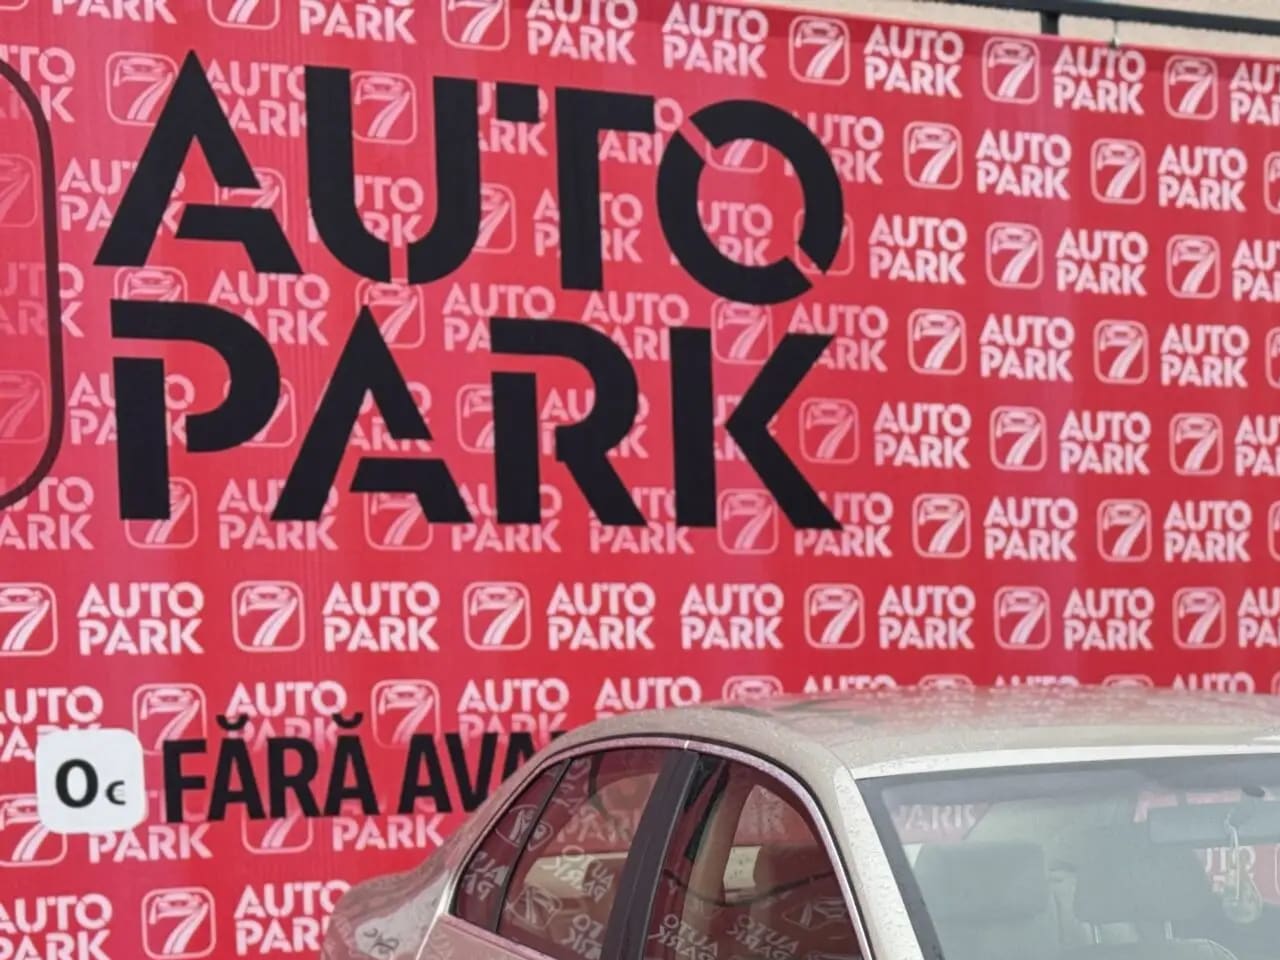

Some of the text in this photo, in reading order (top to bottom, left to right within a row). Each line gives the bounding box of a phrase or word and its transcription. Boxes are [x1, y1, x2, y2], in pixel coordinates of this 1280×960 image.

[300, 5, 416, 44] PARK
[527, 0, 637, 29] AUTO
[662, 2, 769, 43] AUTO
[528, 20, 636, 65] PARK
[664, 34, 766, 78] PARK
[864, 24, 964, 64] AUTO
[865, 56, 962, 98] PARK
[1053, 46, 1146, 81] AUTO
[1054, 75, 1144, 115] PARK
[976, 129, 1071, 167] AUTO
[1158, 144, 1247, 180] AUTO
[94, 50, 843, 304] AUTO
[977, 161, 1070, 200] PARK
[1159, 174, 1246, 212] PARK
[869, 214, 967, 251] AUTO
[1056, 228, 1148, 263] AUTO
[870, 247, 966, 285] PARK
[1057, 259, 1147, 296] PARK
[208, 270, 330, 308] AUTO
[442, 282, 556, 320] AUTO
[581, 290, 689, 326] AUTO
[788, 303, 889, 338] AUTO
[980, 314, 1075, 349] AUTO
[1161, 324, 1249, 356] AUTO
[981, 345, 1073, 382] PARK
[1161, 353, 1248, 388] PARK
[111, 298, 842, 529] PARK
[874, 402, 971, 436] AUTO
[1060, 410, 1151, 443] AUTO
[875, 434, 970, 469] PARK
[1060, 441, 1150, 475] PARK
[984, 496, 1078, 529] AUTO
[1164, 500, 1252, 531] AUTO
[0, 514, 94, 551] ARK
[985, 526, 1077, 562] PARK
[1164, 530, 1251, 562] PARK
[77, 582, 204, 618] AUTO
[323, 581, 440, 617] AUTO
[547, 582, 656, 616] AUTO
[680, 583, 784, 616] AUTO
[879, 585, 976, 617] AUTO
[1063, 587, 1154, 619] AUTO
[79, 619, 204, 656] PARK
[324, 617, 440, 652] PARK
[549, 615, 655, 650] PARK
[682, 615, 783, 649] PARK
[880, 617, 974, 649] PARK
[1064, 618, 1153, 650] PARK
[0, 686, 104, 726] UTO
[226, 681, 347, 717] AUTO
[457, 678, 570, 713] AUTO
[595, 677, 702, 711] AUTO
[163, 713, 378, 823] FĂRĂ
[332, 814, 444, 851] PARK
